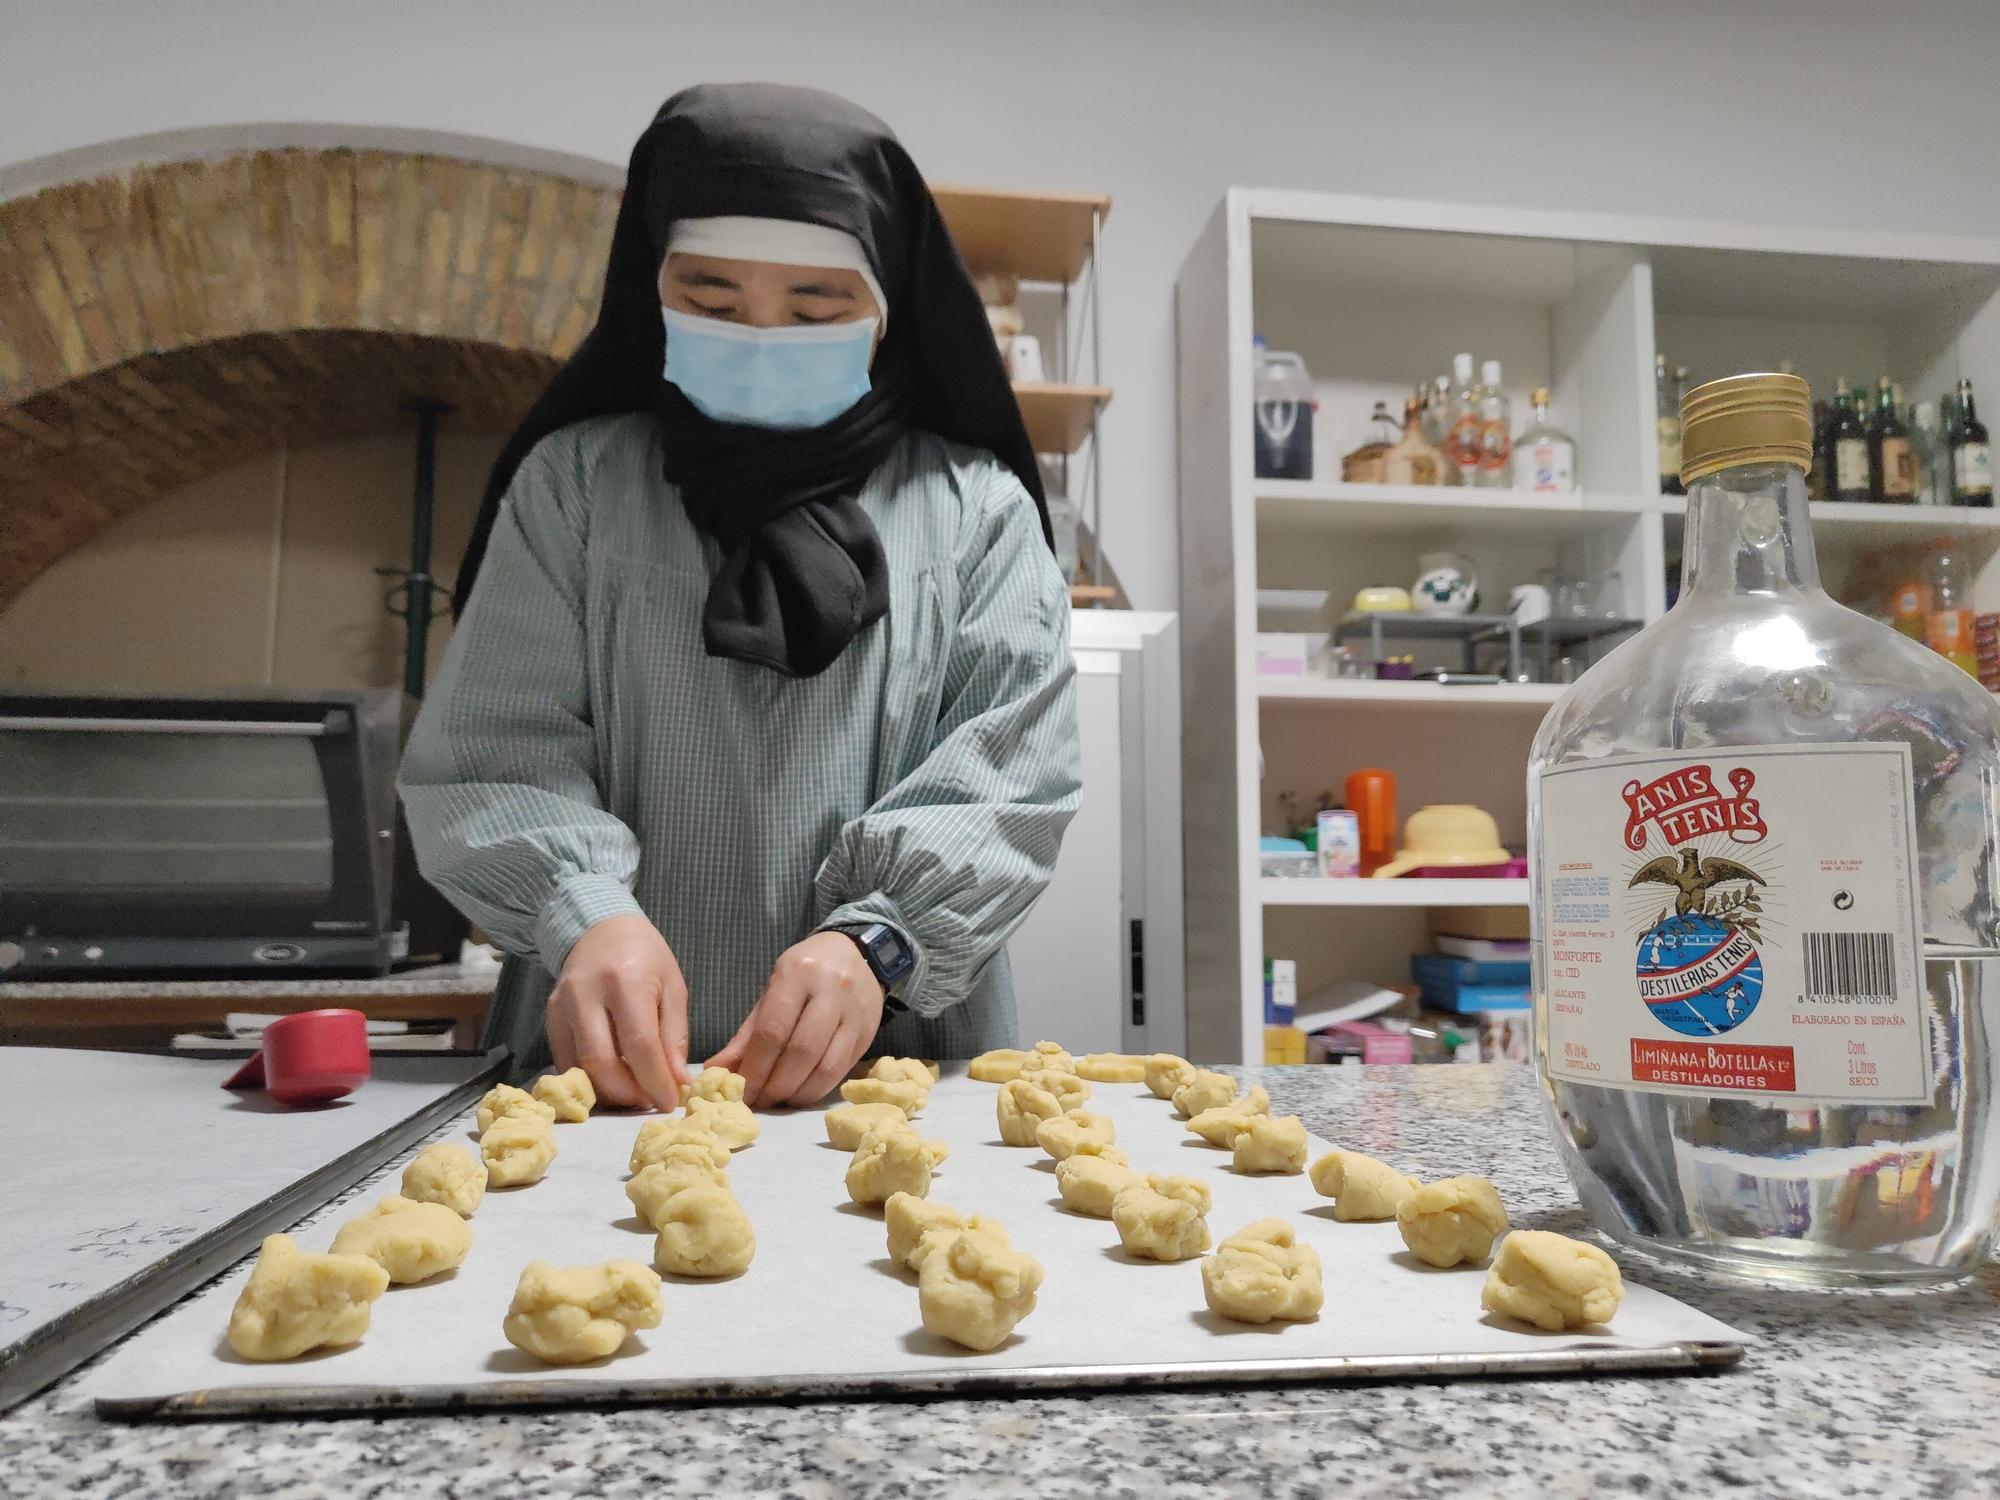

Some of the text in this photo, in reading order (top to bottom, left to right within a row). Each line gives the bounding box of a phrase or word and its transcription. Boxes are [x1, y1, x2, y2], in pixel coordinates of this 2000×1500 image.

[1636, 771, 1708, 819] ANIS
[1662, 802, 1758, 840] TENIS
[1553, 951, 1602, 962] MONFORTE
[1641, 937, 1752, 996] DESTILERIAS TENIS
[1797, 995, 1895, 1004] 8 410548 010010
[1791, 1013, 1905, 1025] ELABORADO EN ESPAÑA
[1634, 1042, 1699, 1067] LIMIÑANA
[1848, 1059, 1877, 1074] 3 Litros
[1652, 1069, 1766, 1087] DESTILADORES
[1849, 1077, 1879, 1086] SECO
